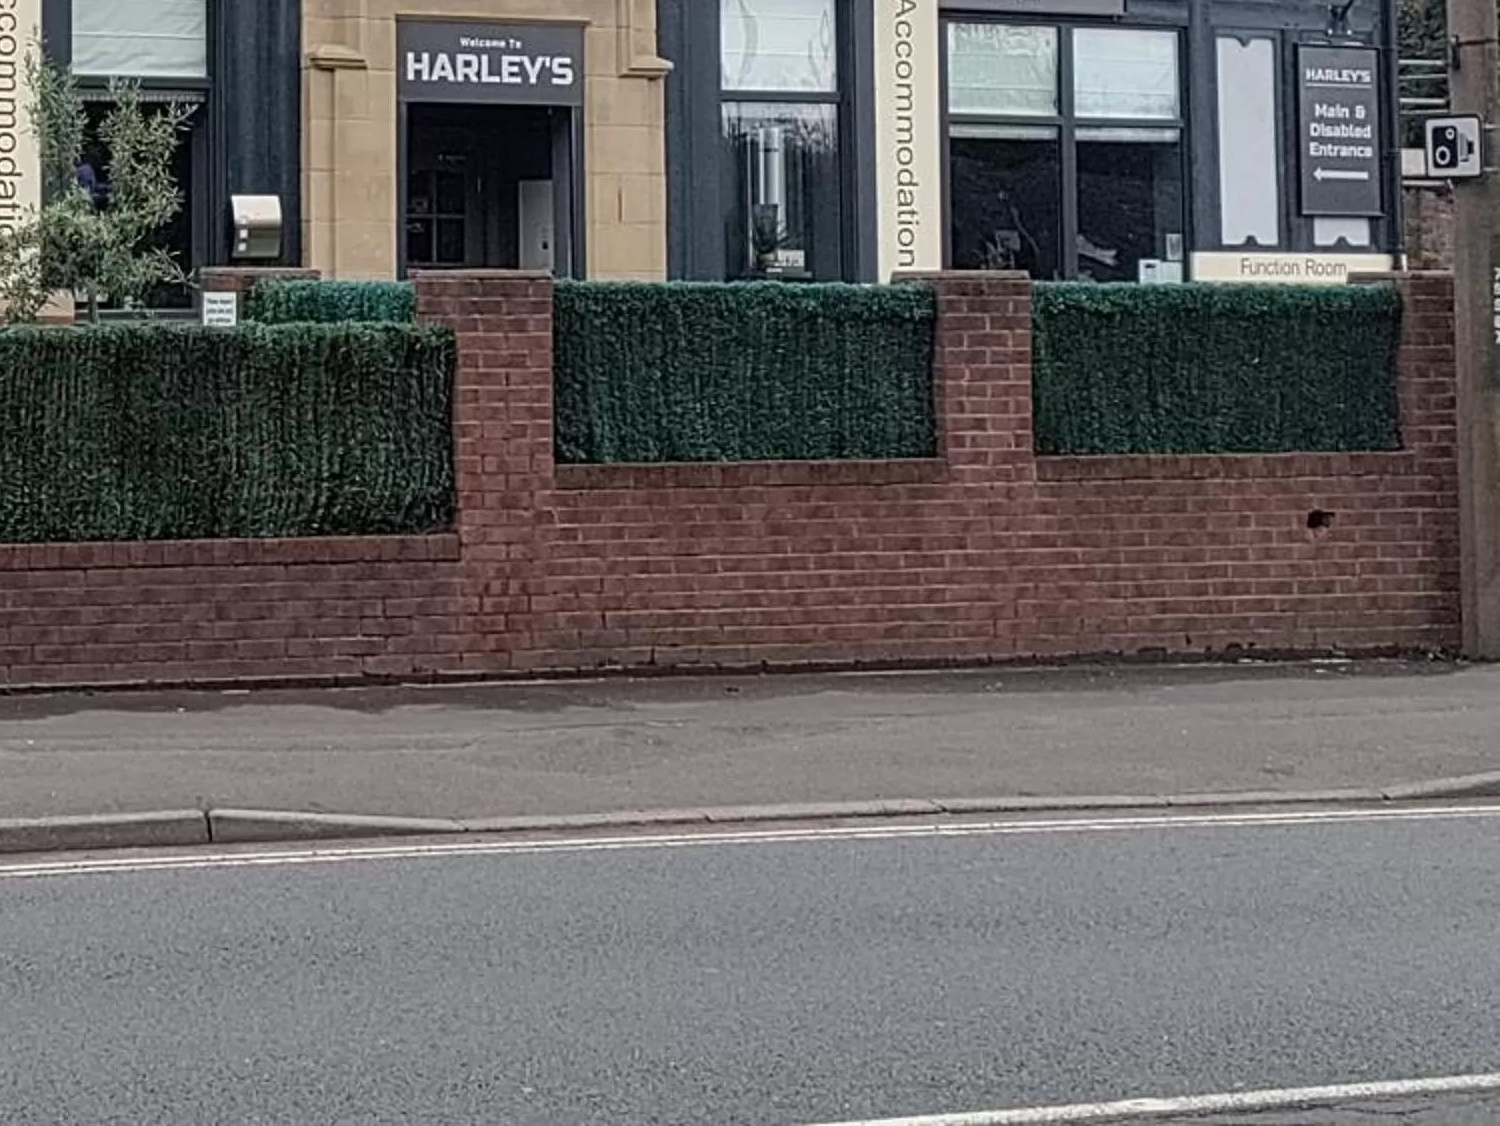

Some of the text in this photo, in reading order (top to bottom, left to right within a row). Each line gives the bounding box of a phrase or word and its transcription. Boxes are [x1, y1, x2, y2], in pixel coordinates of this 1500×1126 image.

[459, 37, 505, 48] Welcome
[406, 51, 574, 86] HARLEY'S
[1305, 68, 1371, 83] HARLEY'S
[1315, 103, 1349, 119] Main
[1309, 122, 1371, 139] Disabled
[1309, 142, 1372, 157] Entrance
[1240, 257, 1346, 276] Function Room
